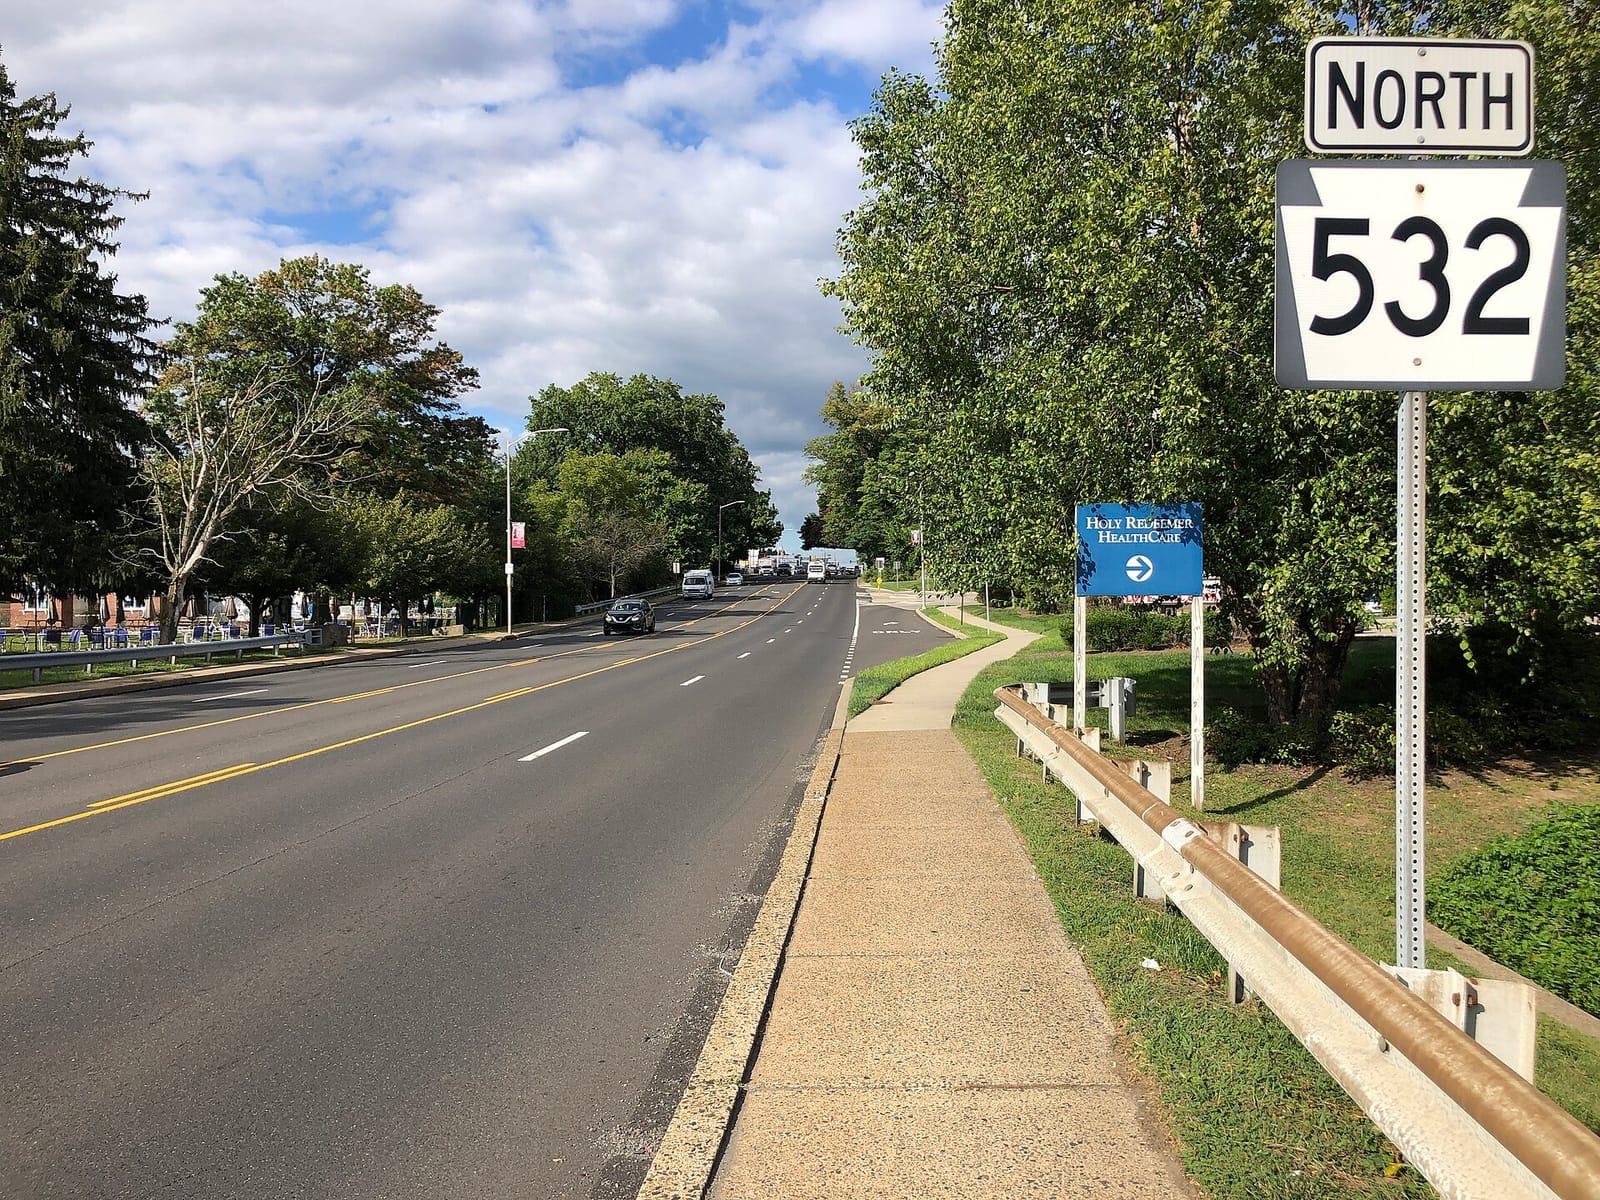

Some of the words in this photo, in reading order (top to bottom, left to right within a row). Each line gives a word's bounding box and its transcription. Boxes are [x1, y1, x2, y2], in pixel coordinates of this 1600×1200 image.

[1327, 61, 1513, 130] NORTH
[1309, 216, 1531, 338] 532
[1086, 516, 1124, 529] HOLY
[1125, 516, 1194, 529] REDEEMER
